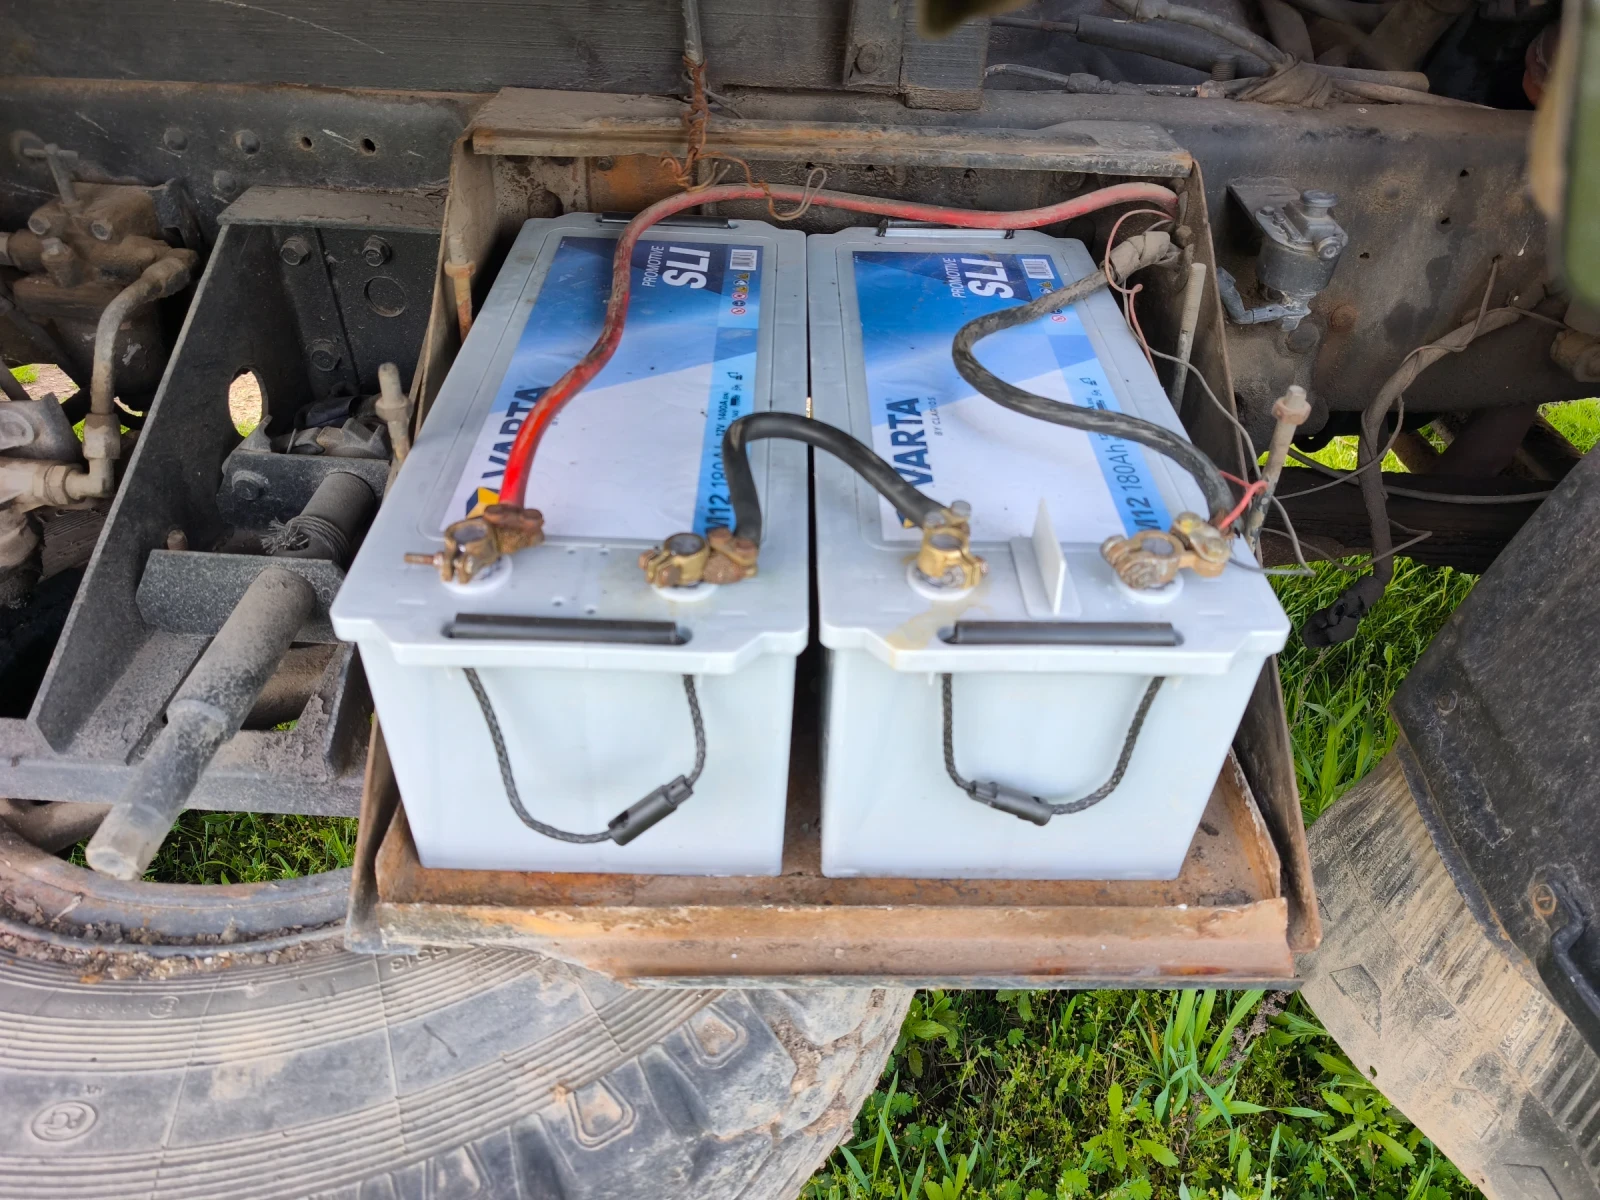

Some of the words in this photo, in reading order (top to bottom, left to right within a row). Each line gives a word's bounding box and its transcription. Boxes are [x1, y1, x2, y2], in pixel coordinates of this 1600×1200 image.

[642, 245, 664, 288] PROMOTIVE
[662, 246, 711, 289] SLI
[942, 257, 966, 298] PROMOTIVE
[960, 258, 1014, 299] SLI
[885, 397, 935, 489] VARTA
[1105, 444, 1142, 492] 180Ah
